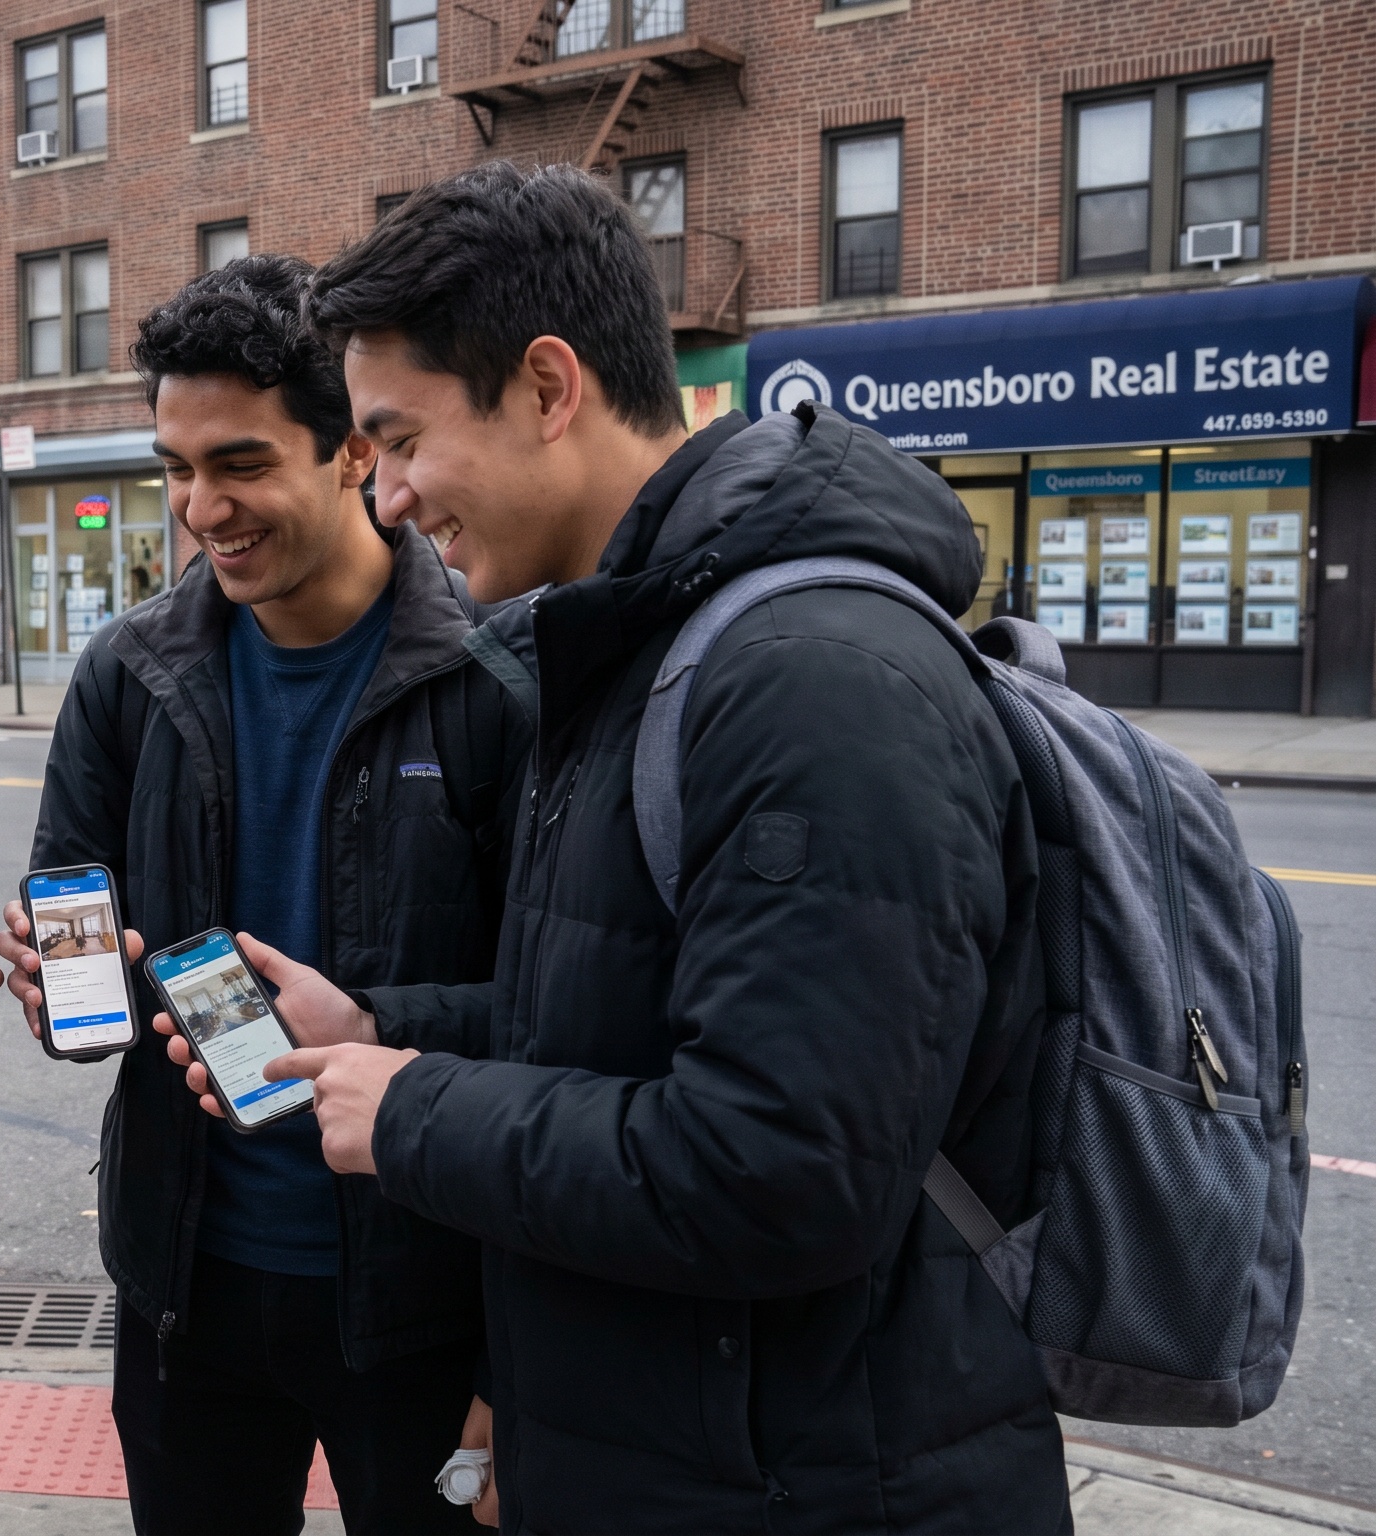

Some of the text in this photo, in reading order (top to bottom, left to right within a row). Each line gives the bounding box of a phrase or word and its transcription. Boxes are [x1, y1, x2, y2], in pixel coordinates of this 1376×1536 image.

[845, 346, 1330, 420] Queensboro Real Estate
